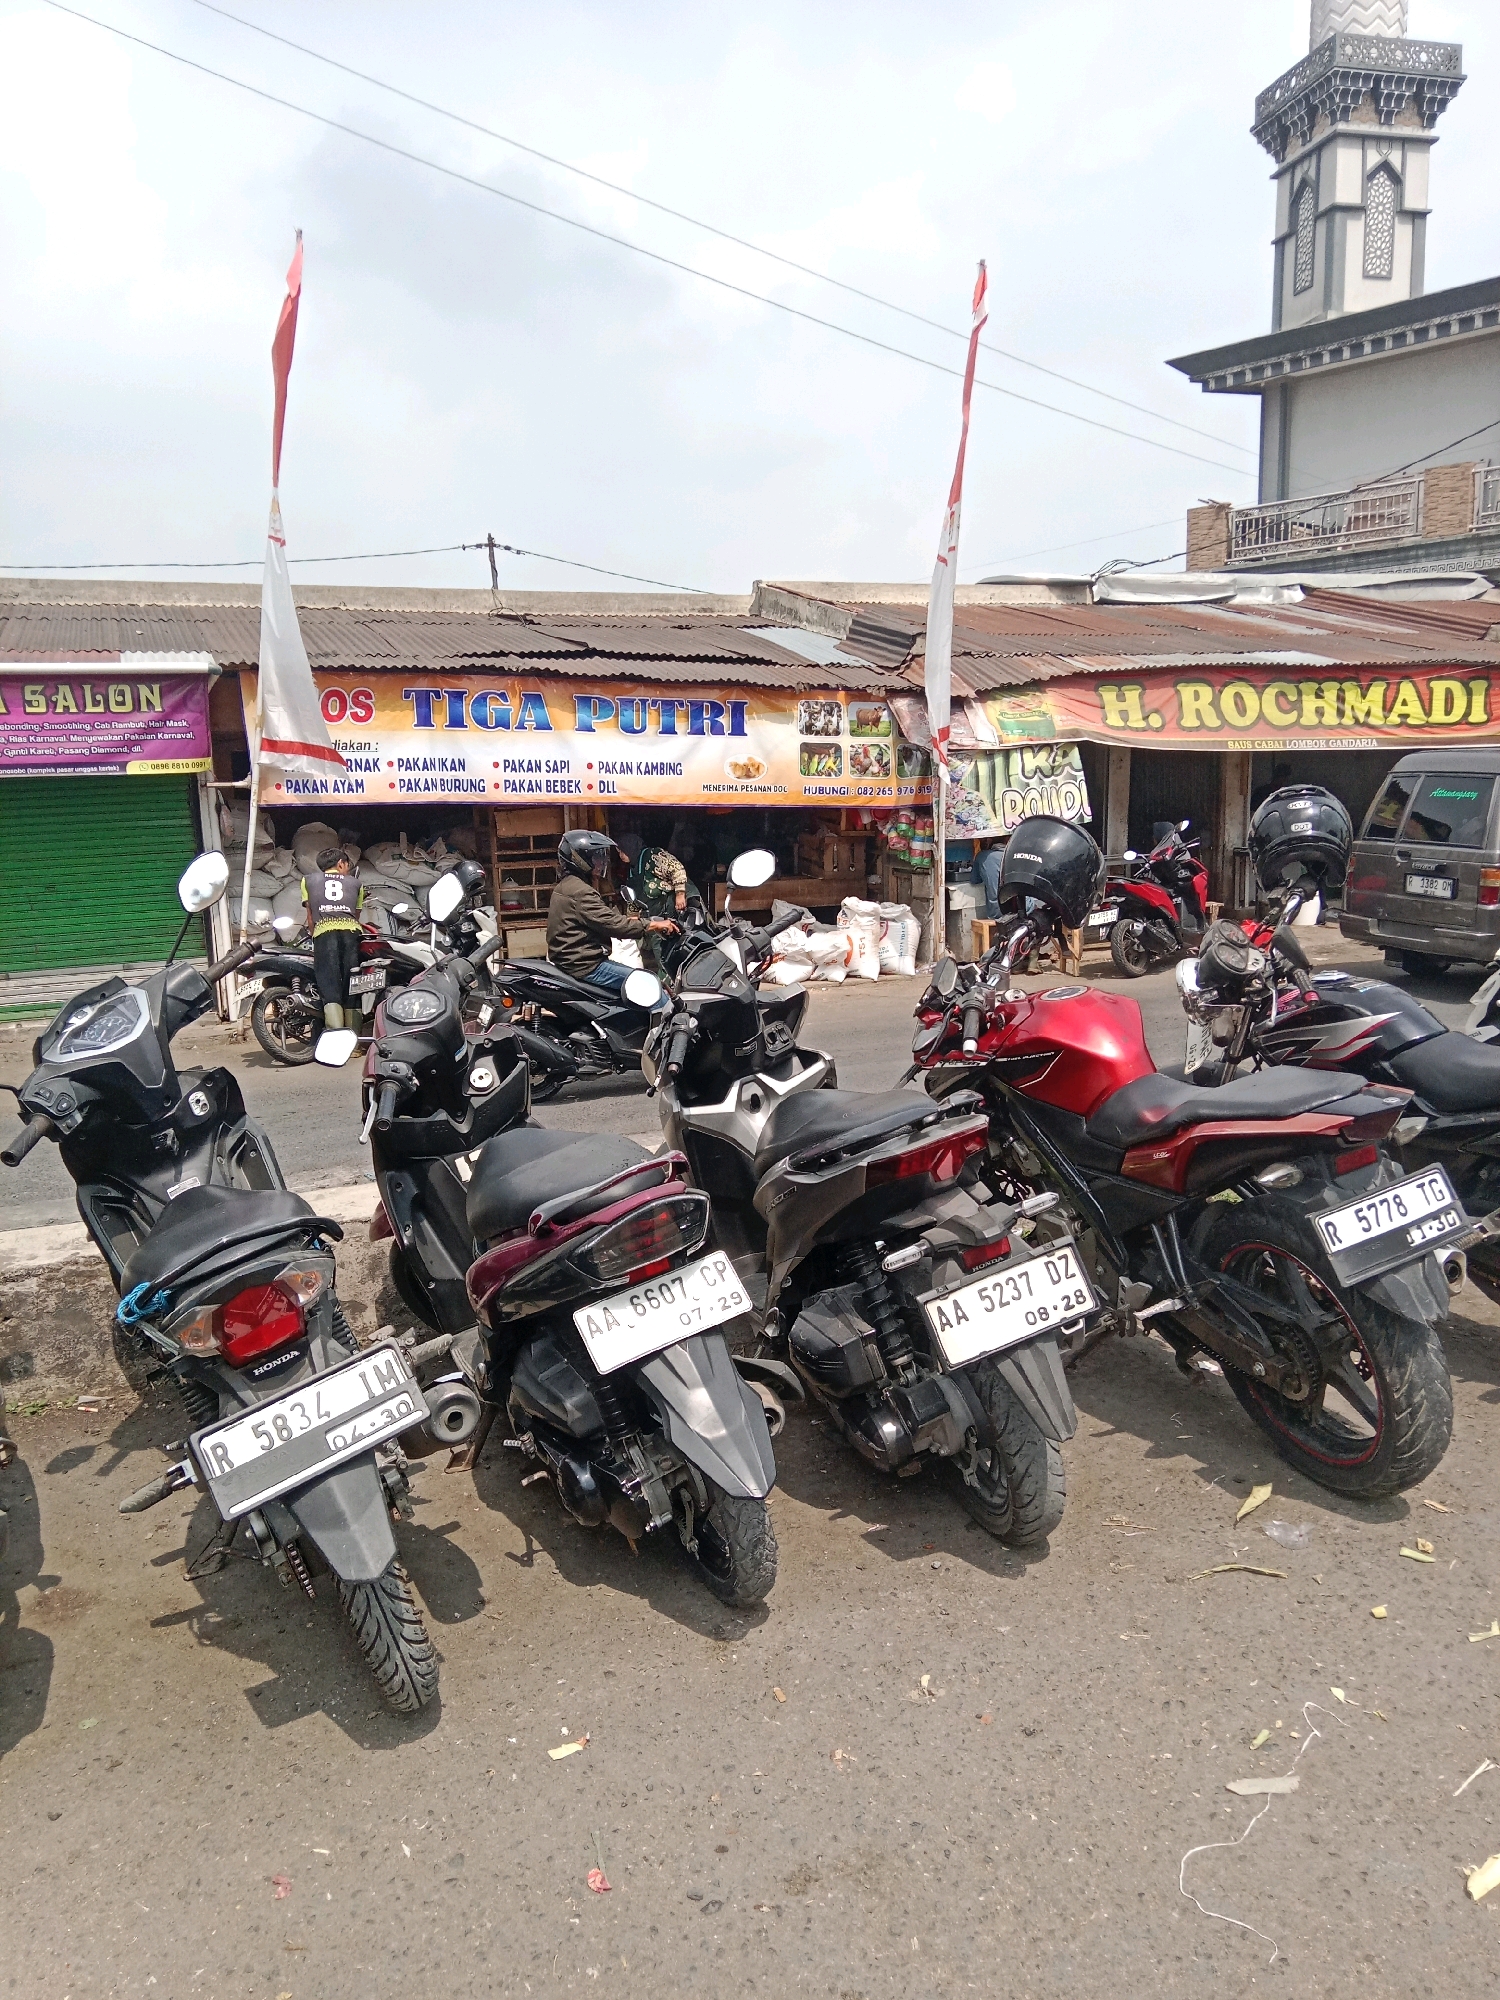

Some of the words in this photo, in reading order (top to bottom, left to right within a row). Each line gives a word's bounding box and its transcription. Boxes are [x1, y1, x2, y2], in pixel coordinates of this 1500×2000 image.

[24, 684, 163, 712] SALON
[1099, 685, 1163, 729] H.
[1177, 679, 1489, 728] ROCHMADI
[320, 687, 375, 725] OS
[403, 688, 553, 731] TIGA
[573, 694, 748, 737] PUTRI
[1227, 740, 1252, 749] SAUS
[1255, 740, 1283, 749] CABAI
[1286, 739, 1326, 749] LOMBOK
[346, 757, 381, 773] RNAK
[398, 758, 437, 773] PAKAN
[438, 758, 466, 773] IKAN
[503, 759, 542, 774] PAKAN
[544, 760, 570, 774] SAPI
[598, 761, 633, 776] PAKAN
[636, 761, 683, 776] KAMBING
[286, 779, 328, 794] PAKAN
[333, 779, 365, 794] AYAM
[398, 779, 438, 793] PAKAN
[439, 779, 486, 794] BURUNG
[503, 779, 542, 794] PAKAN
[545, 780, 582, 794] BEBEK
[598, 780, 617, 794] DLL
[702, 784, 739, 793] MENERIMA
[740, 784, 772, 793] PESANAN
[857, 786, 874, 796] 082
[876, 786, 893, 796] 265
[1013, 853, 1043, 864] HONDA
[324, 880, 343, 901] 8
[1323, 1220, 1343, 1247] R
[1354, 1193, 1408, 1233] 5778
[1415, 1178, 1446, 1206] TG
[972, 1256, 1004, 1272] HONDA
[586, 1306, 620, 1339] AA
[629, 1276, 687, 1317] 6607
[699, 1260, 728, 1287] CP
[936, 1299, 969, 1332] AA
[977, 1271, 1033, 1313] 5237
[1044, 1253, 1076, 1286] DZ
[252, 1350, 301, 1377] HONDA
[210, 1441, 235, 1474] R
[251, 1391, 331, 1451] 5834
[359, 1358, 401, 1399] IM
